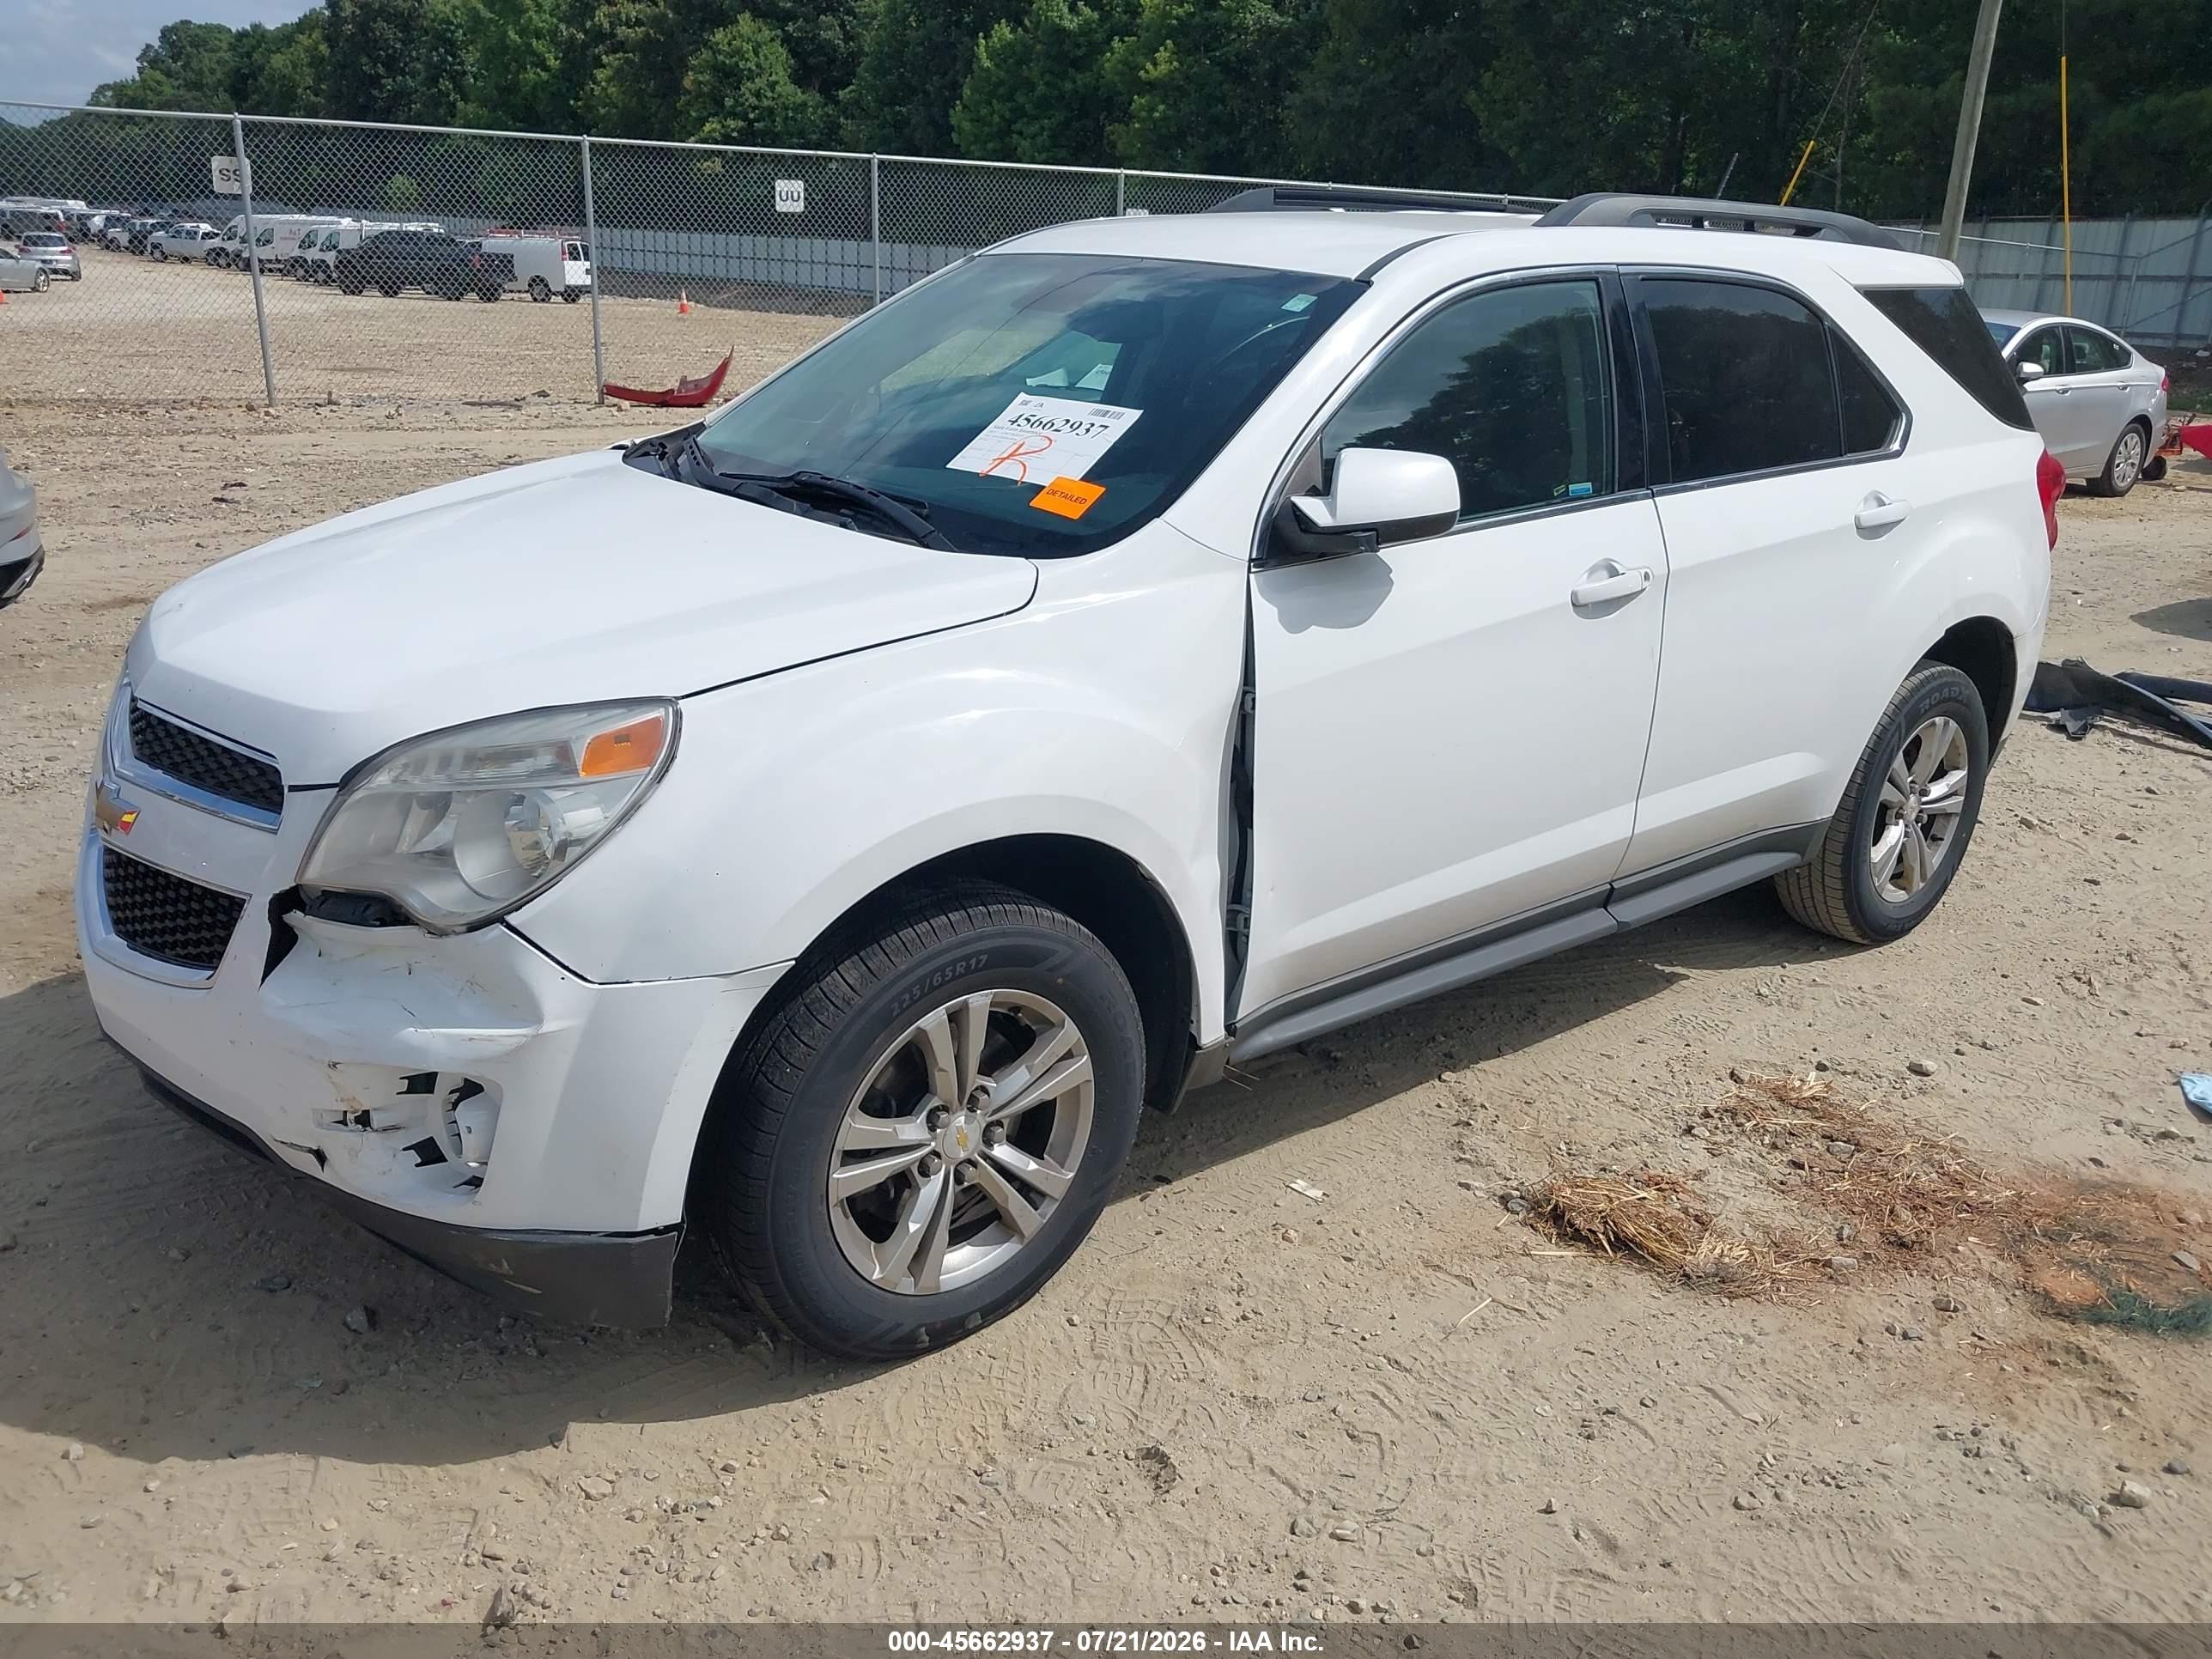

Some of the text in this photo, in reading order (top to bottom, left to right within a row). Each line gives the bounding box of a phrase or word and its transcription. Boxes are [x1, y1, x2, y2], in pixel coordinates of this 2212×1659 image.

[779, 190, 800, 203] UU
[1007, 412, 1111, 440] 45662937
[1046, 488, 1088, 506] DETAILED
[890, 954, 988, 1016] 225/65R17
